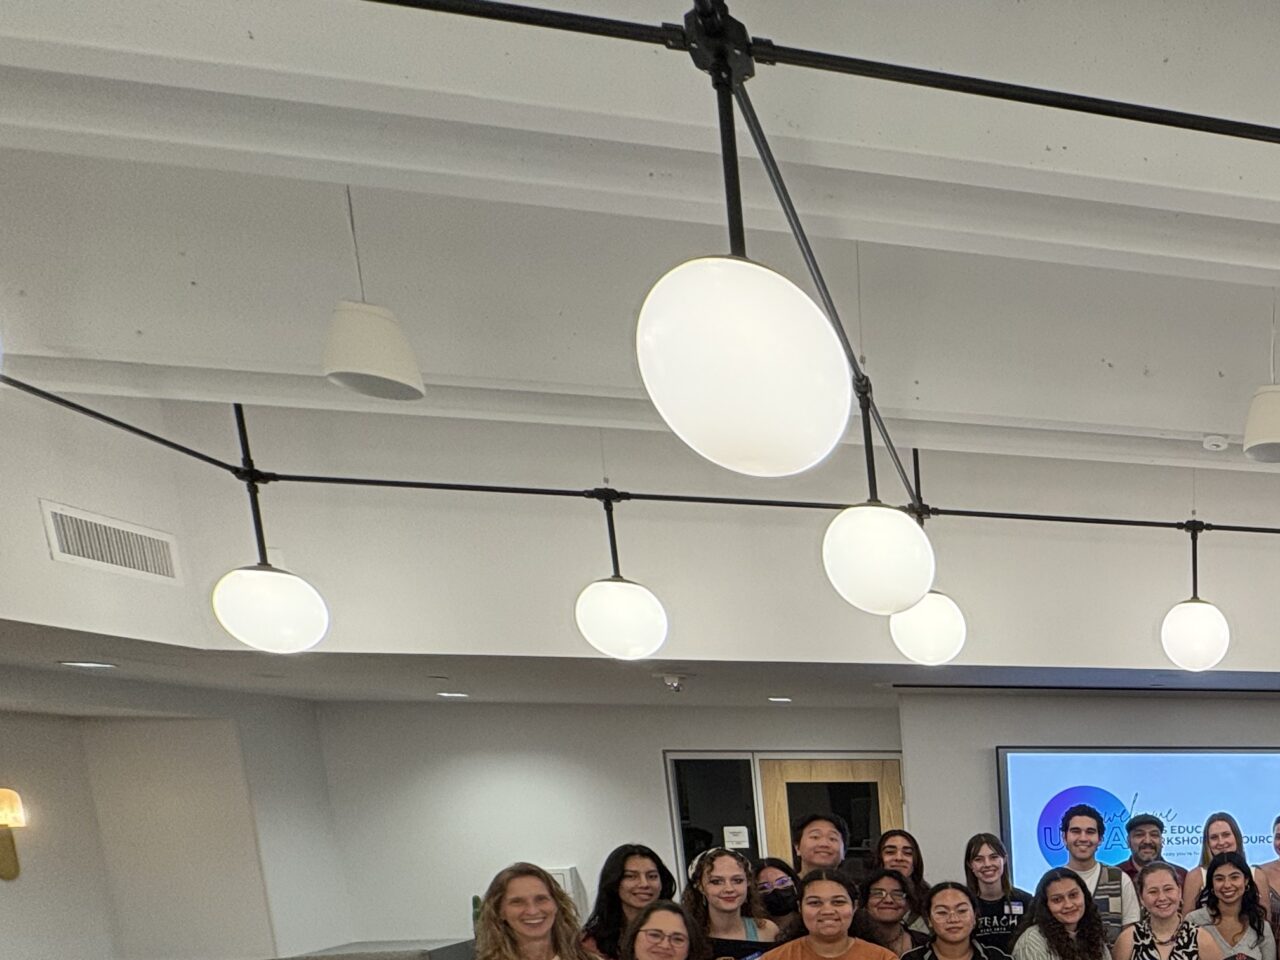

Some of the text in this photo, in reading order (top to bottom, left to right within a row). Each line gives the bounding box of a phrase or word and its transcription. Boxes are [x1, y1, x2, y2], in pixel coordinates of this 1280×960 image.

[1170, 825, 1202, 834] EDUC
[1243, 835, 1273, 844] OURC
[977, 915, 1018, 929] TEACH
